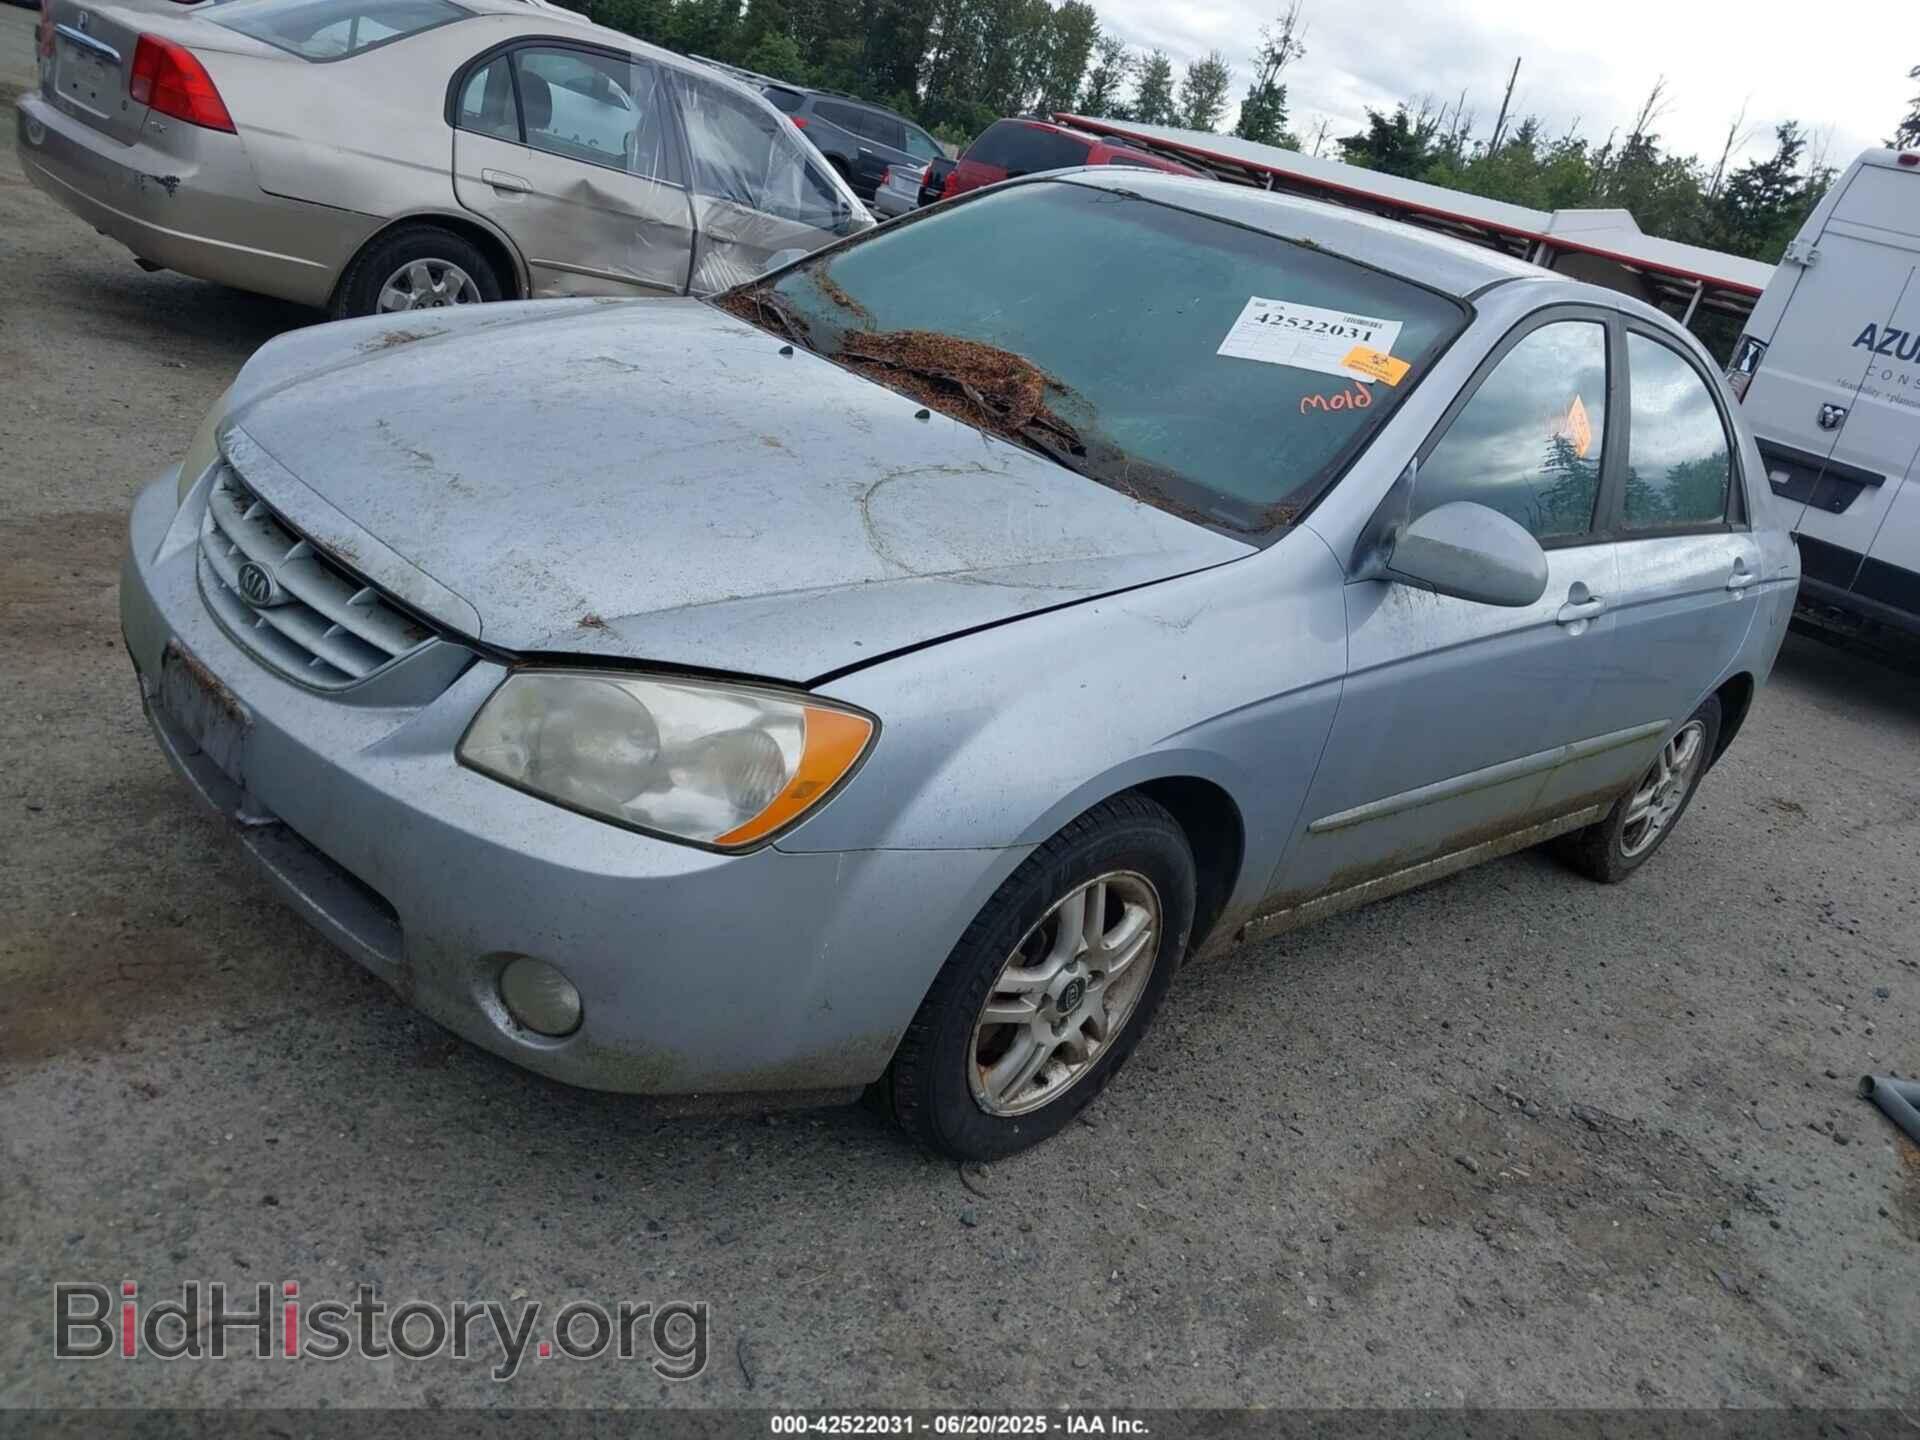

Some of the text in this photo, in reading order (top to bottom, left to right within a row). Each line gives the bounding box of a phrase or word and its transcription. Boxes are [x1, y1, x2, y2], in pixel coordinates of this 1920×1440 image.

[1255, 312, 1373, 342] 42522031
[1852, 322, 1920, 364] AZU
[241, 566, 267, 600] KIA
